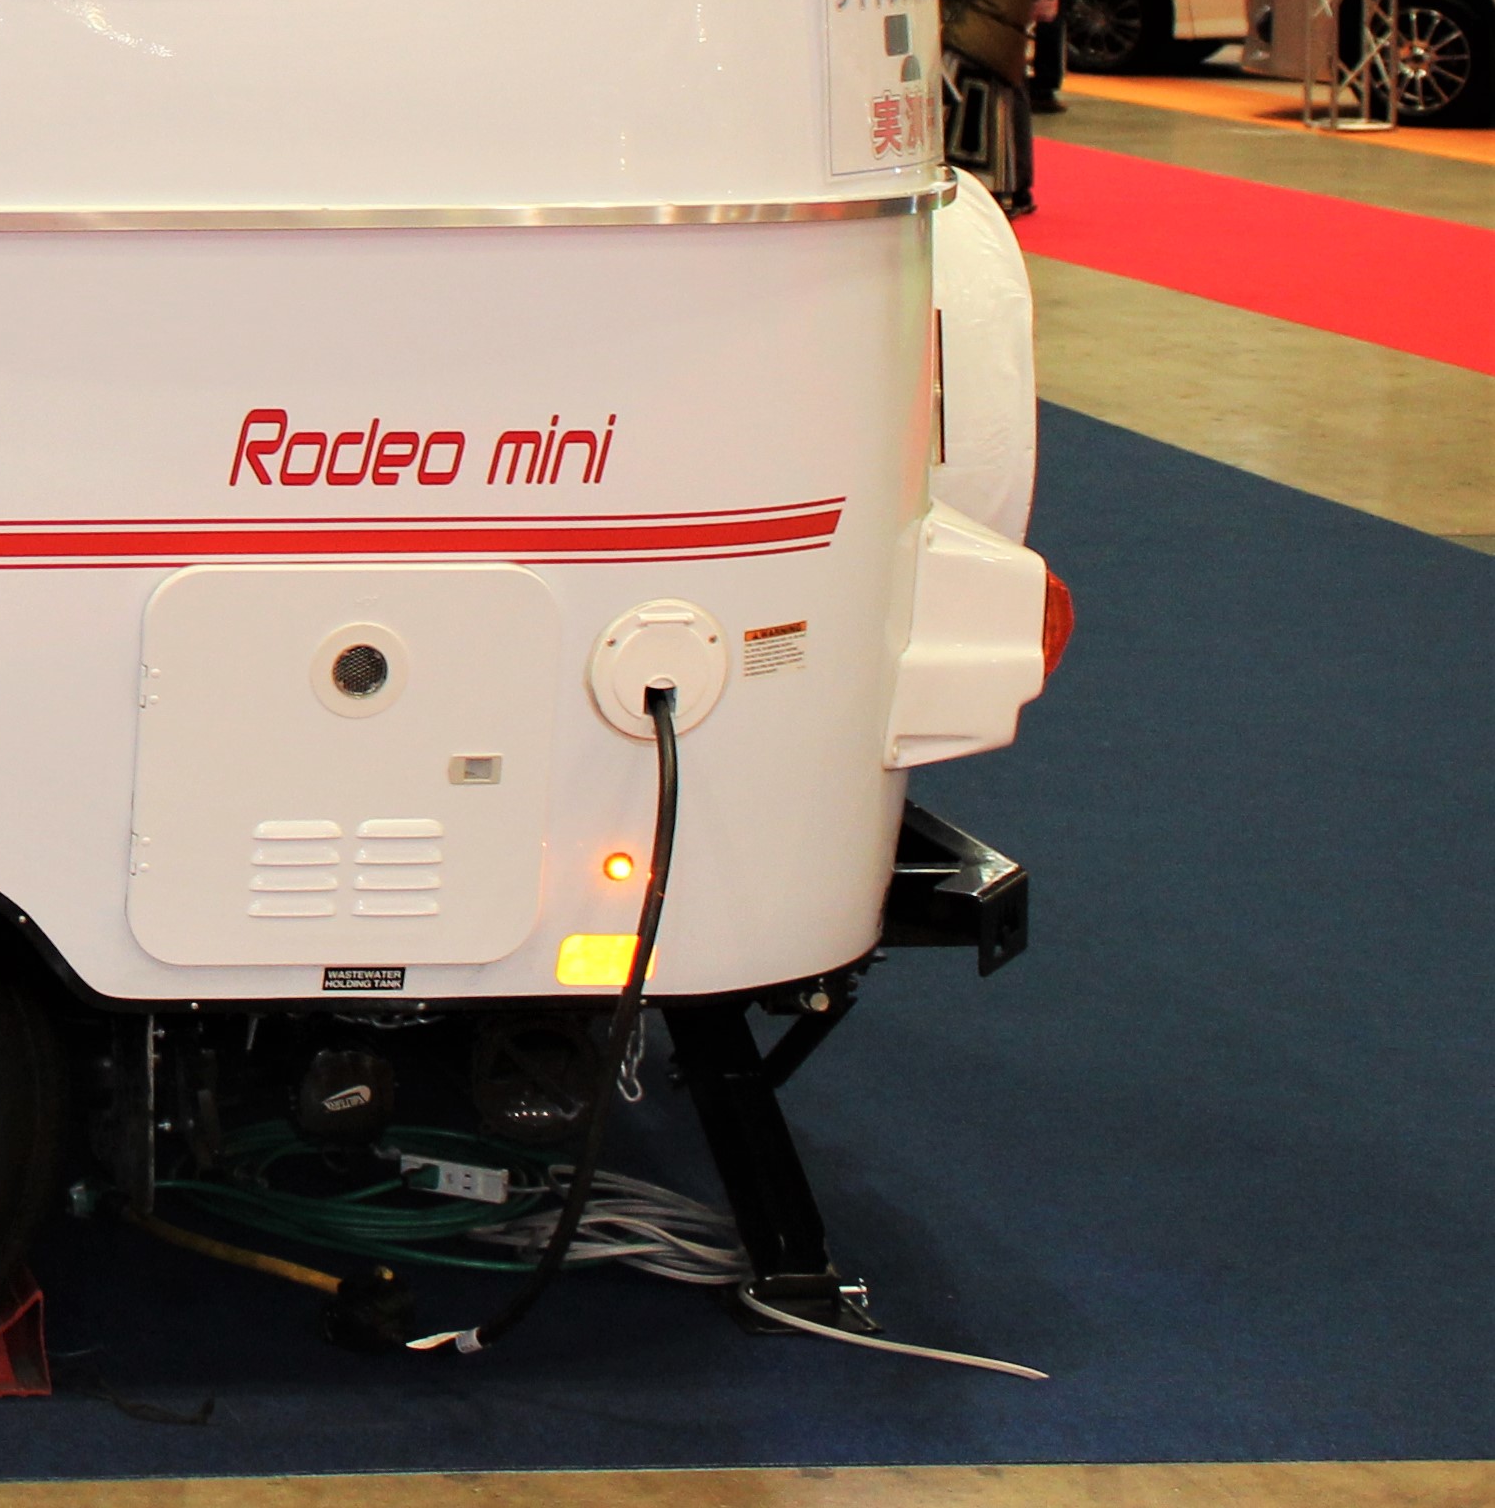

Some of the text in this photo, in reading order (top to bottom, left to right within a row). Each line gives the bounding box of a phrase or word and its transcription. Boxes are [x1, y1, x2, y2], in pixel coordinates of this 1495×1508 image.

[229, 408, 617, 487] Rodeo mini
[328, 970, 402, 980] WASTEWATER
[325, 980, 401, 989] HOLDING TANK
